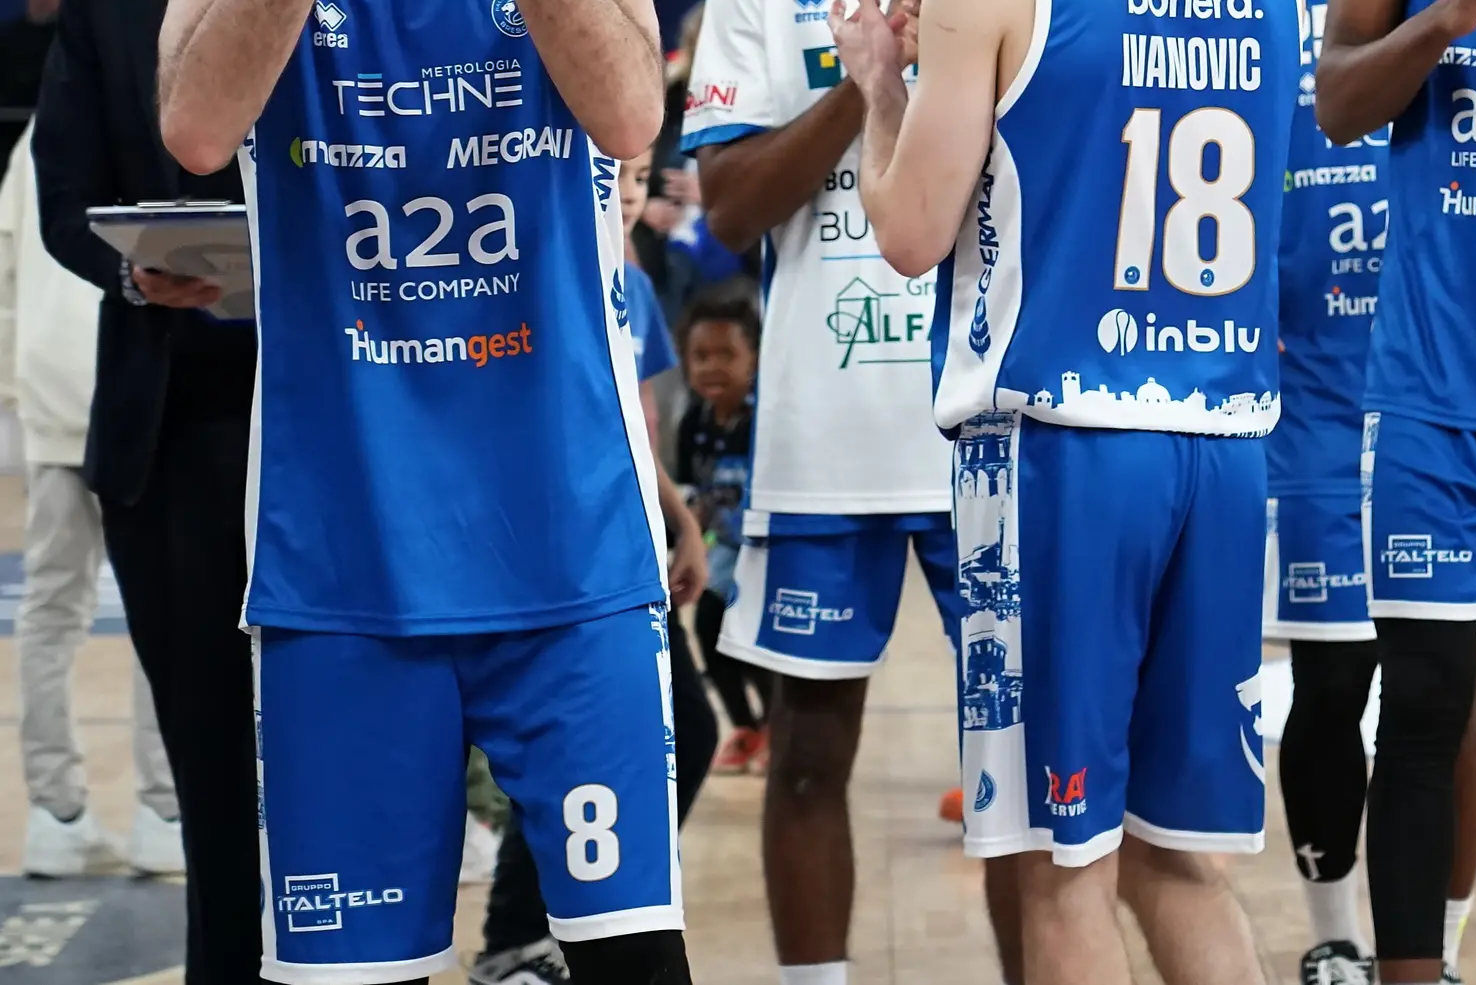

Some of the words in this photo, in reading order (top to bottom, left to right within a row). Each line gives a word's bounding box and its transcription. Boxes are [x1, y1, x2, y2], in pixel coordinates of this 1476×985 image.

[421, 58, 522, 78] METROLOGIA
[1122, 33, 1262, 92] IVANOVIC
[1294, 164, 1377, 188] mazza
[1113, 106, 1256, 297] 18
[344, 192, 520, 271] a2a
[1328, 199, 1391, 254] a2
[351, 280, 391, 303] LIFE
[398, 273, 520, 302] COMPANY
[1331, 257, 1363, 275] LIFE
[345, 319, 532, 367] Humangest
[1146, 313, 1261, 354] inblu
[562, 783, 620, 882] 8
[291, 882, 332, 891] GRUPPO
